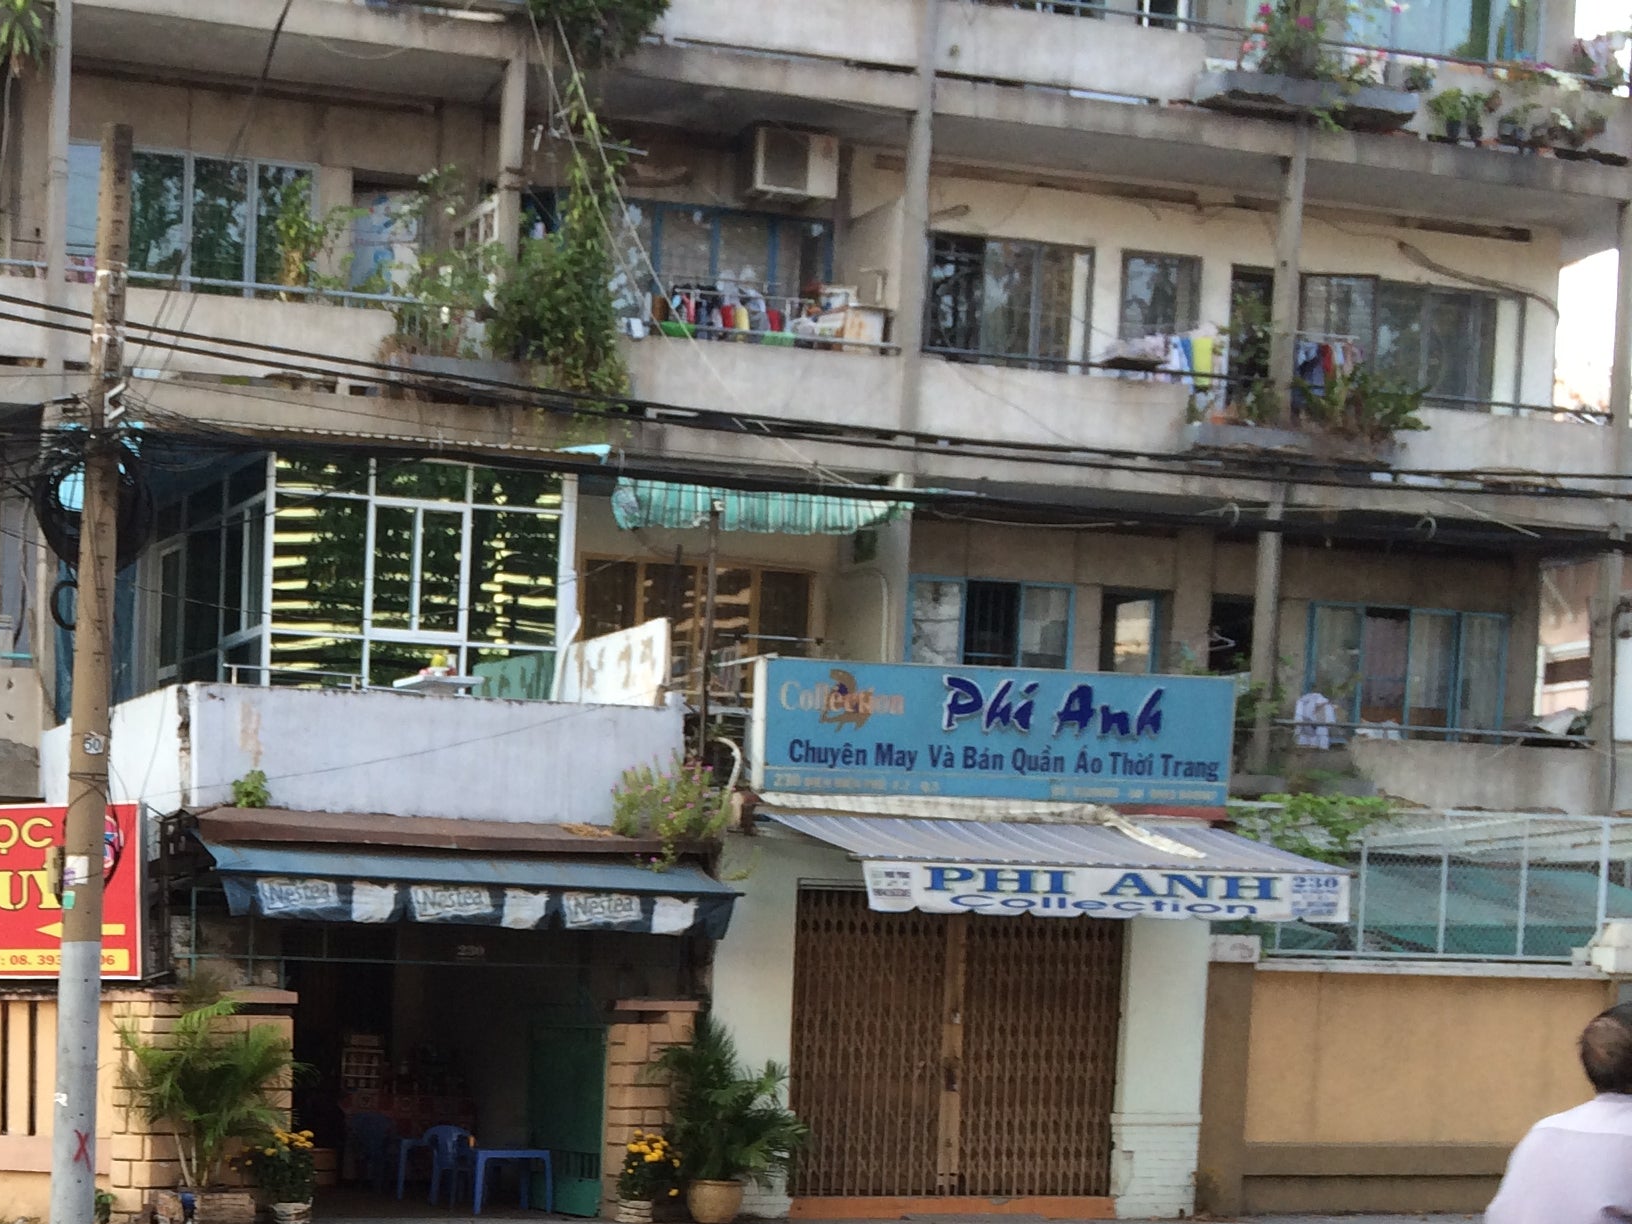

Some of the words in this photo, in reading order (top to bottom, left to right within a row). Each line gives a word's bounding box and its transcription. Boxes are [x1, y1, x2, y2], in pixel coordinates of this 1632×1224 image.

[780, 681, 905, 716] Collection
[941, 674, 1040, 732] Phi
[1051, 684, 1167, 740] Anh
[789, 739, 867, 769] Chuyên
[875, 743, 918, 771] May
[928, 745, 955, 768] Và
[963, 746, 1005, 770] Bán
[1074, 745, 1102, 775] Áo
[1109, 751, 1153, 777] Thời
[1160, 753, 1220, 781] Trang
[923, 866, 1076, 895] PHI
[1100, 872, 1283, 900] ANH
[949, 894, 1257, 913] Collection
[10, 955, 32, 966] 08.
